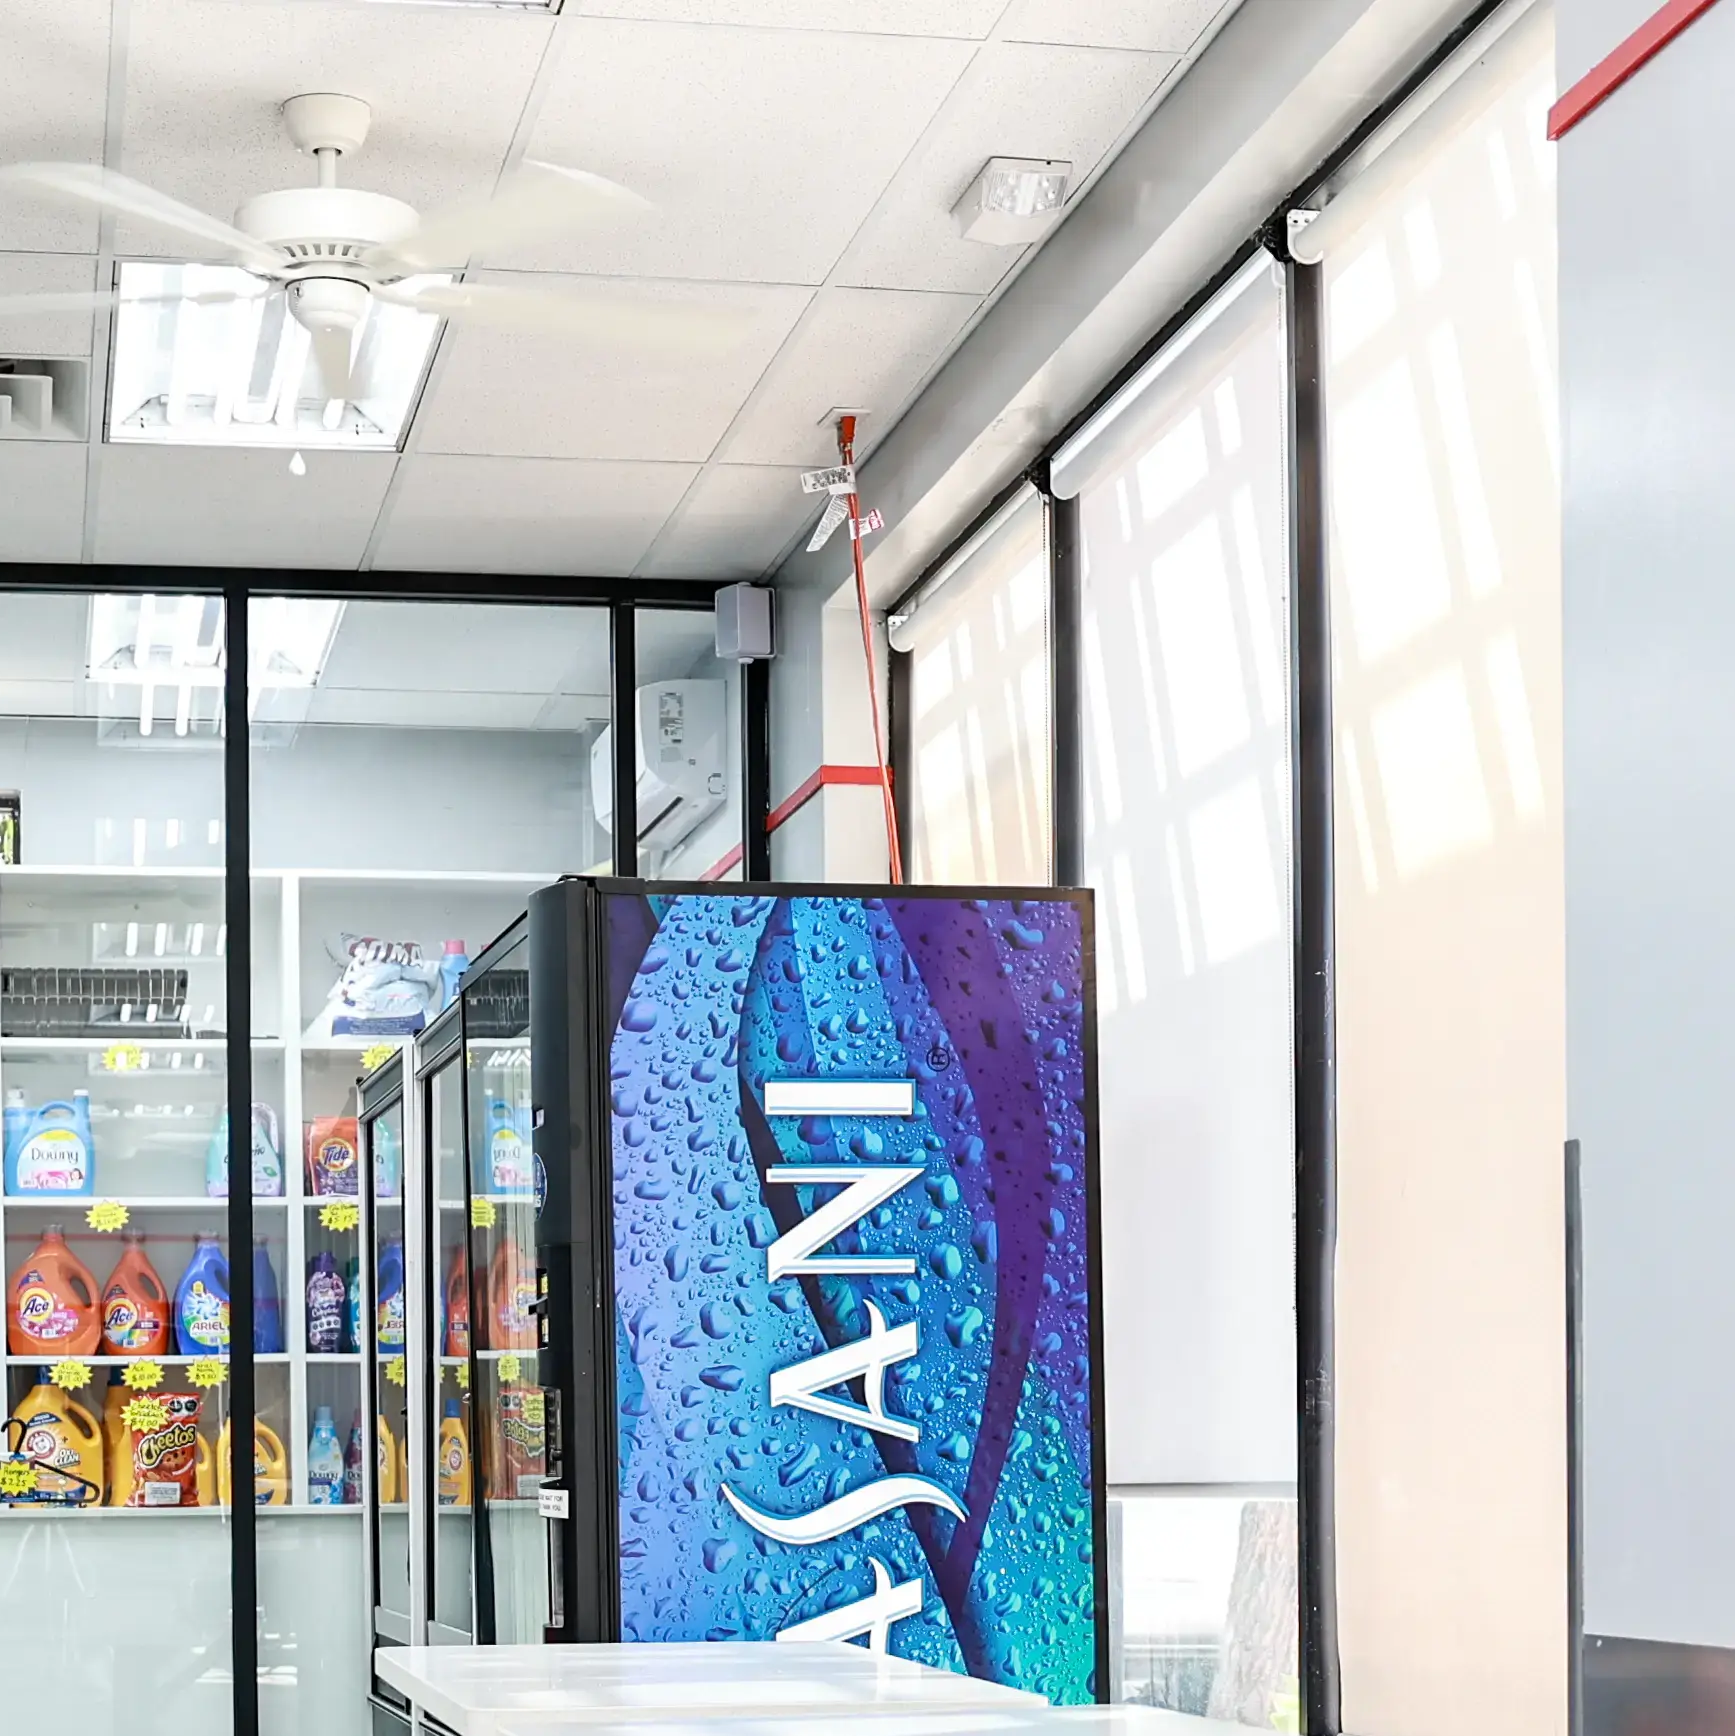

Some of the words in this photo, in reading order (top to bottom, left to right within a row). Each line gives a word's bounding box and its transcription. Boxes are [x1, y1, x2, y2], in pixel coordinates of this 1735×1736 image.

[31, 1147, 79, 1164] Downy
[322, 1148, 350, 1165] Tide
[23, 1298, 49, 1315] Ace
[106, 1311, 134, 1327] Ace
[191, 1321, 225, 1332] ARIEL
[141, 1423, 196, 1464] Cheetos
